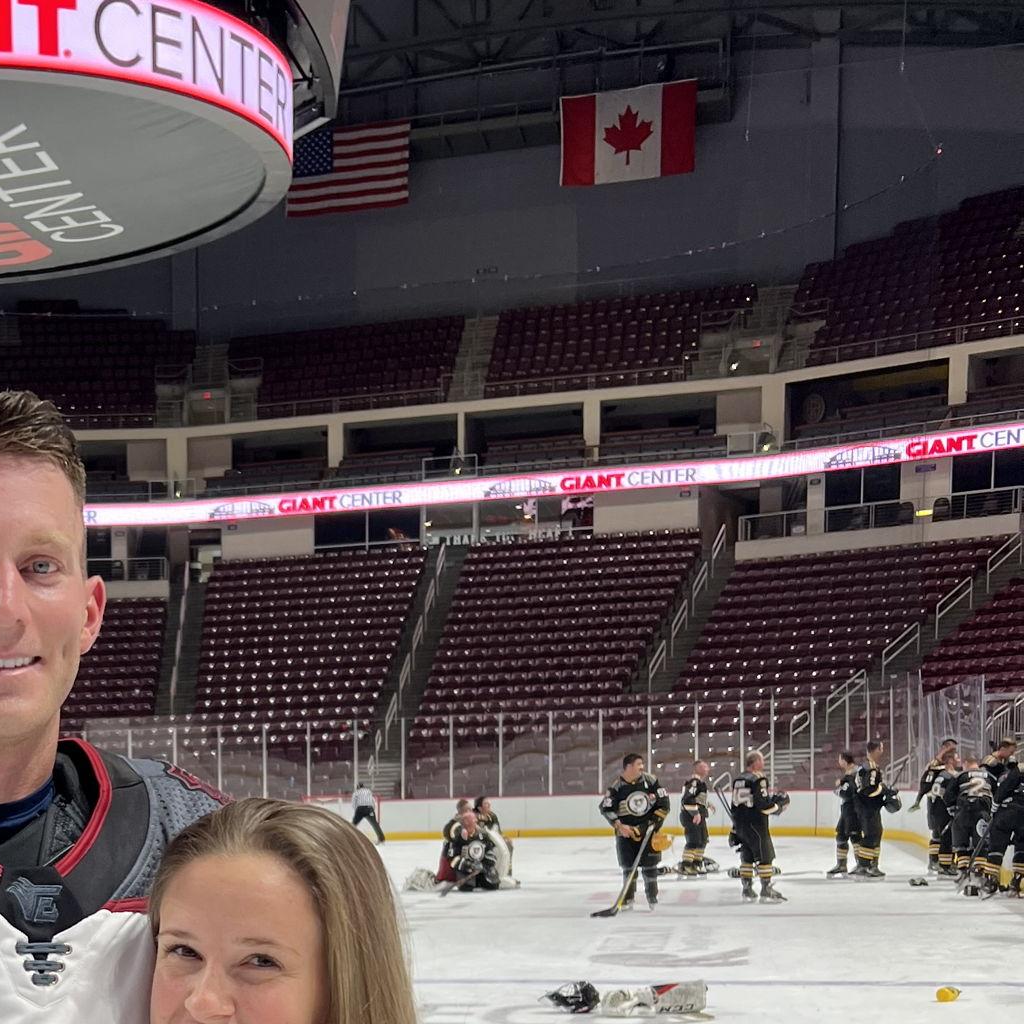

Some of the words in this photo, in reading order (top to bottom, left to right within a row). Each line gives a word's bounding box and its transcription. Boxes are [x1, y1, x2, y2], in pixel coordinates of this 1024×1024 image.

[94, 0, 287, 140] CENTER
[905, 434, 978, 457] GIANT
[980, 428, 1024, 449] CEN
[560, 473, 625, 491] GIANT
[627, 467, 696, 486] CENTER
[278, 495, 337, 513] GIANT
[339, 490, 403, 510] CENTER
